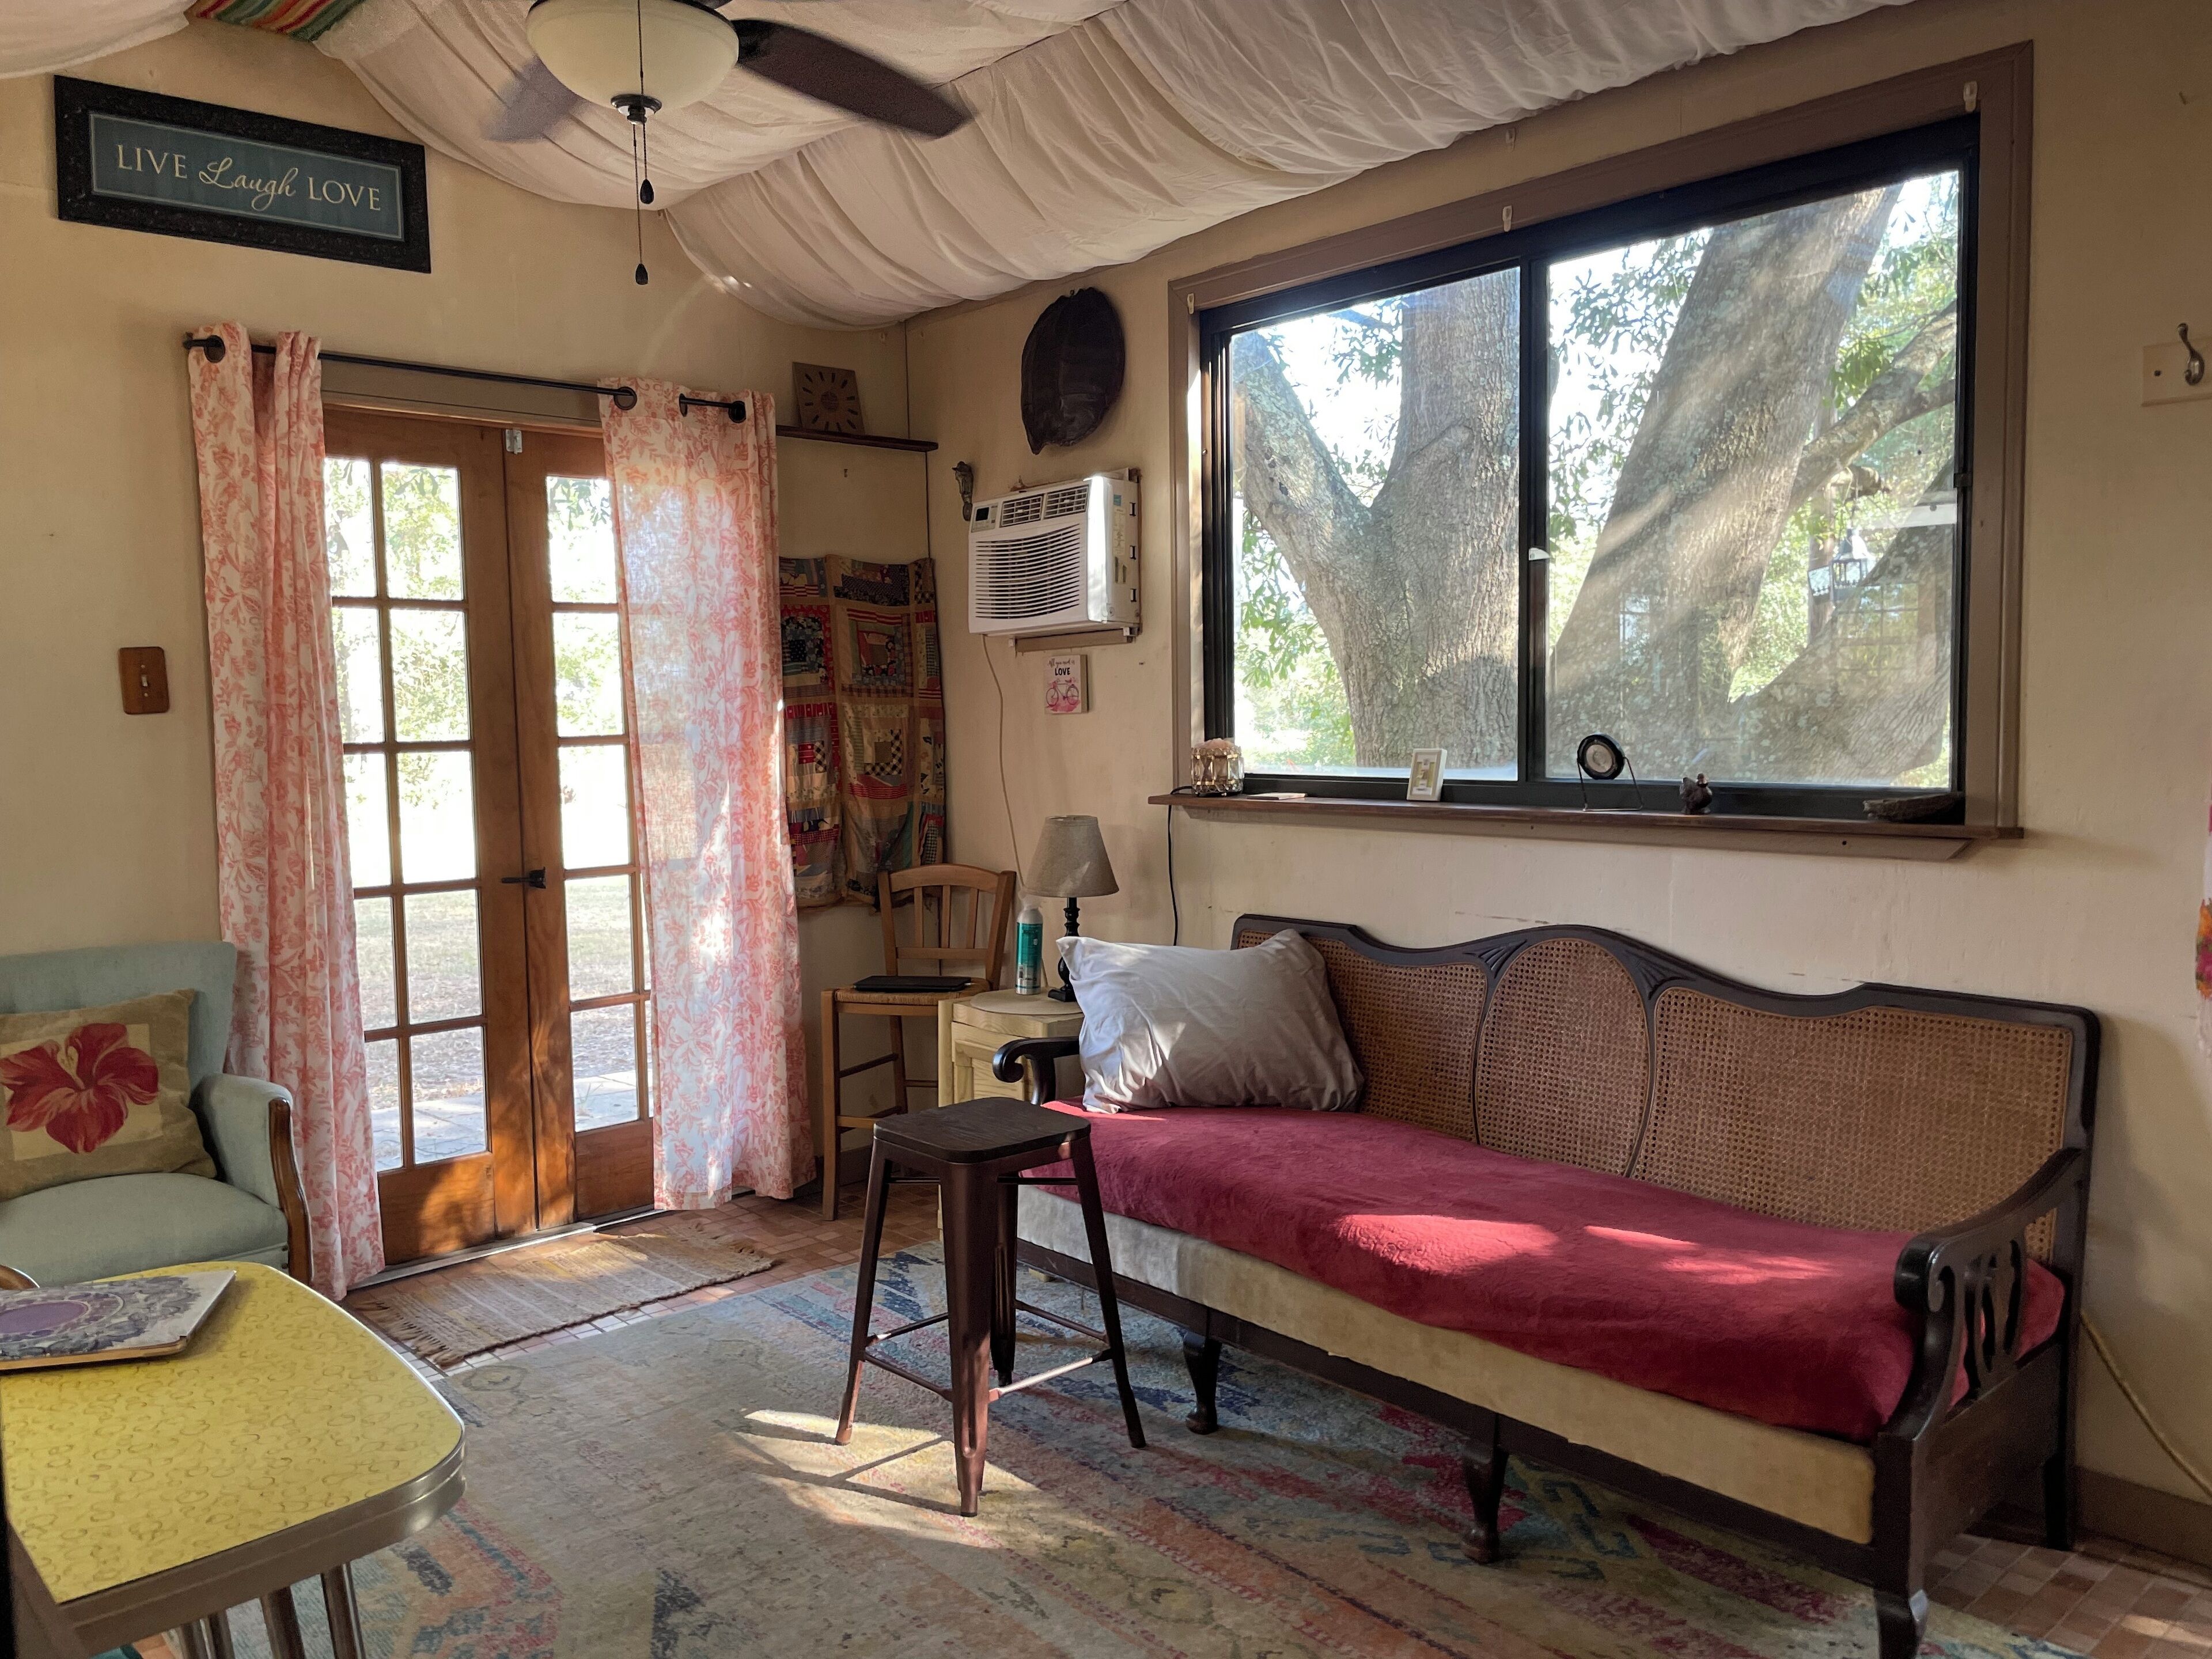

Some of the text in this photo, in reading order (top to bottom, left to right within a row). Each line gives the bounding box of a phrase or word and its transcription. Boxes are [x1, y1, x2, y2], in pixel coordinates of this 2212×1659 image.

[117, 143, 381, 211] LIVE Laugh LOVE
[1055, 667, 1070, 676] LOVE
